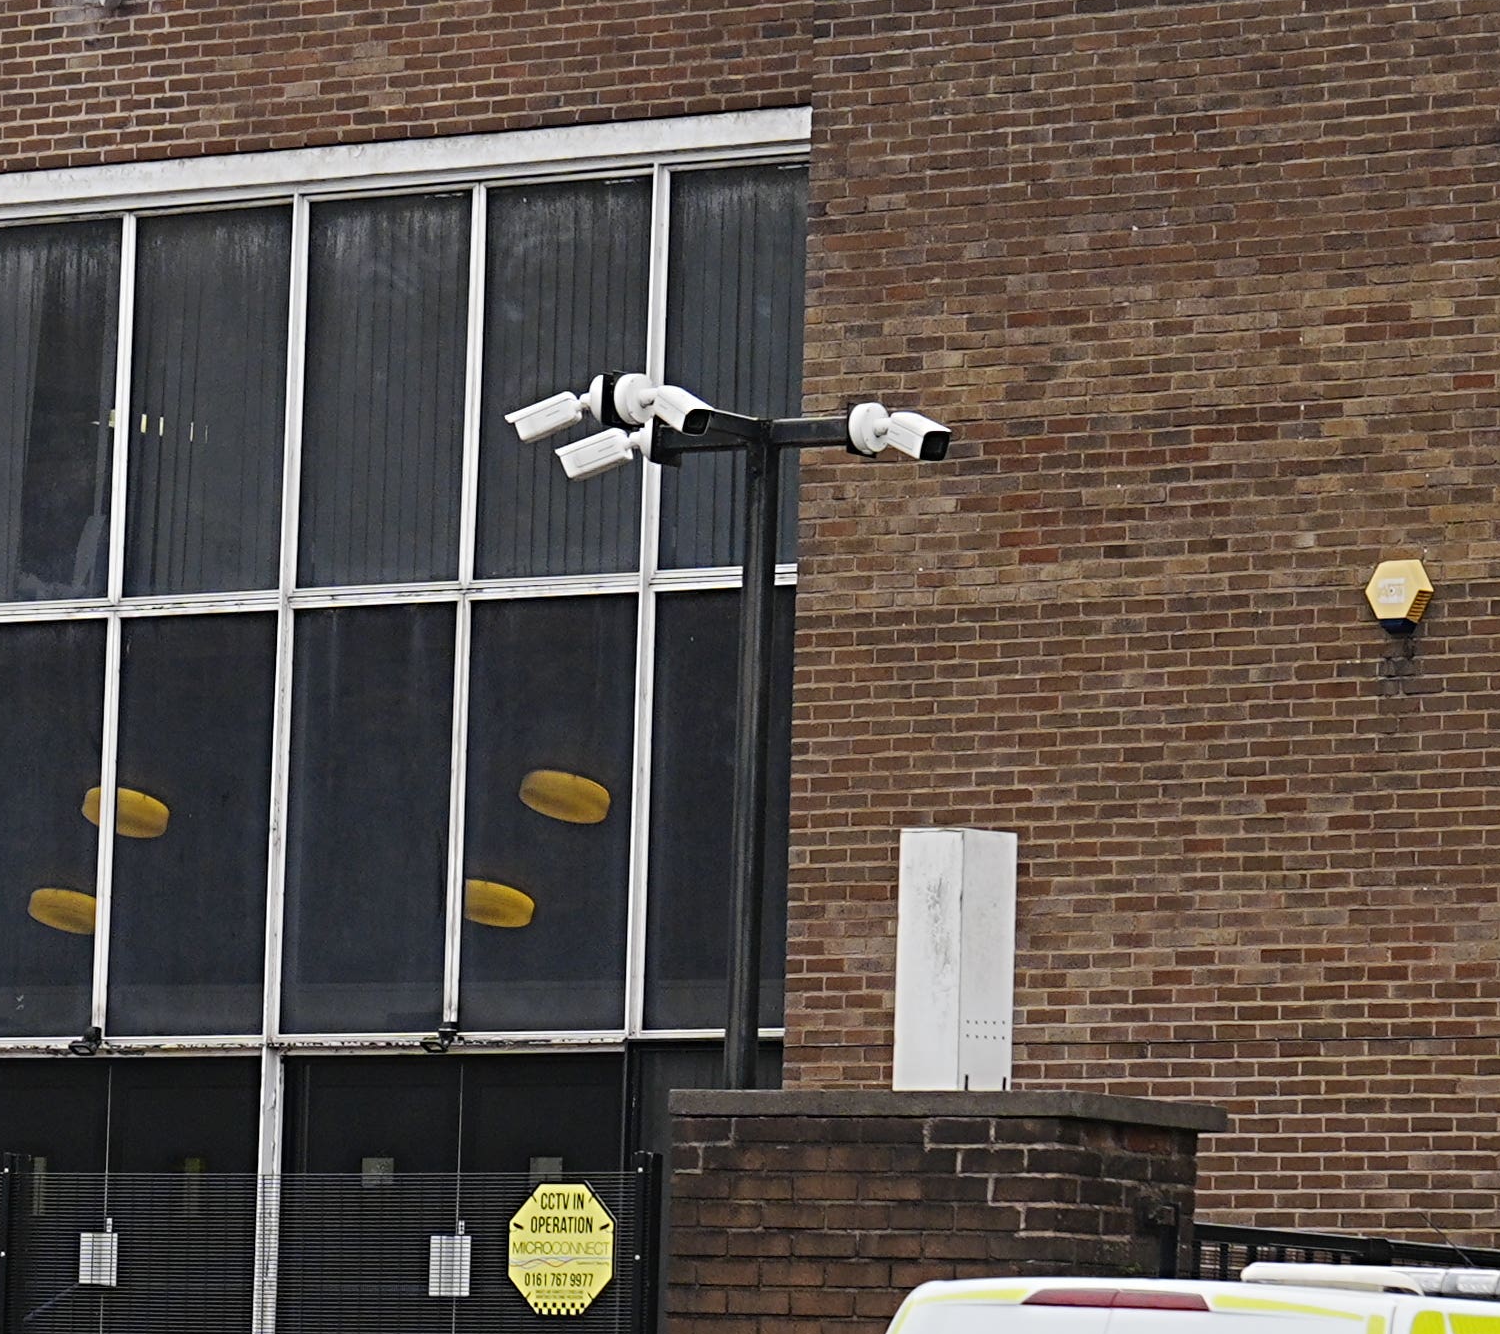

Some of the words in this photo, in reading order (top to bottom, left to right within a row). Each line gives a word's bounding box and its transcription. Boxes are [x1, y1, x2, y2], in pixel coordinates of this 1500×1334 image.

[541, 1192, 570, 1210] CCTV
[573, 1192, 585, 1210] IN
[530, 1216, 593, 1233] OPERATION
[512, 1241, 610, 1255] MICROCONNECT
[524, 1272, 548, 1287] 0161
[551, 1272, 568, 1287] 767
[569, 1273, 594, 1287] 9977
